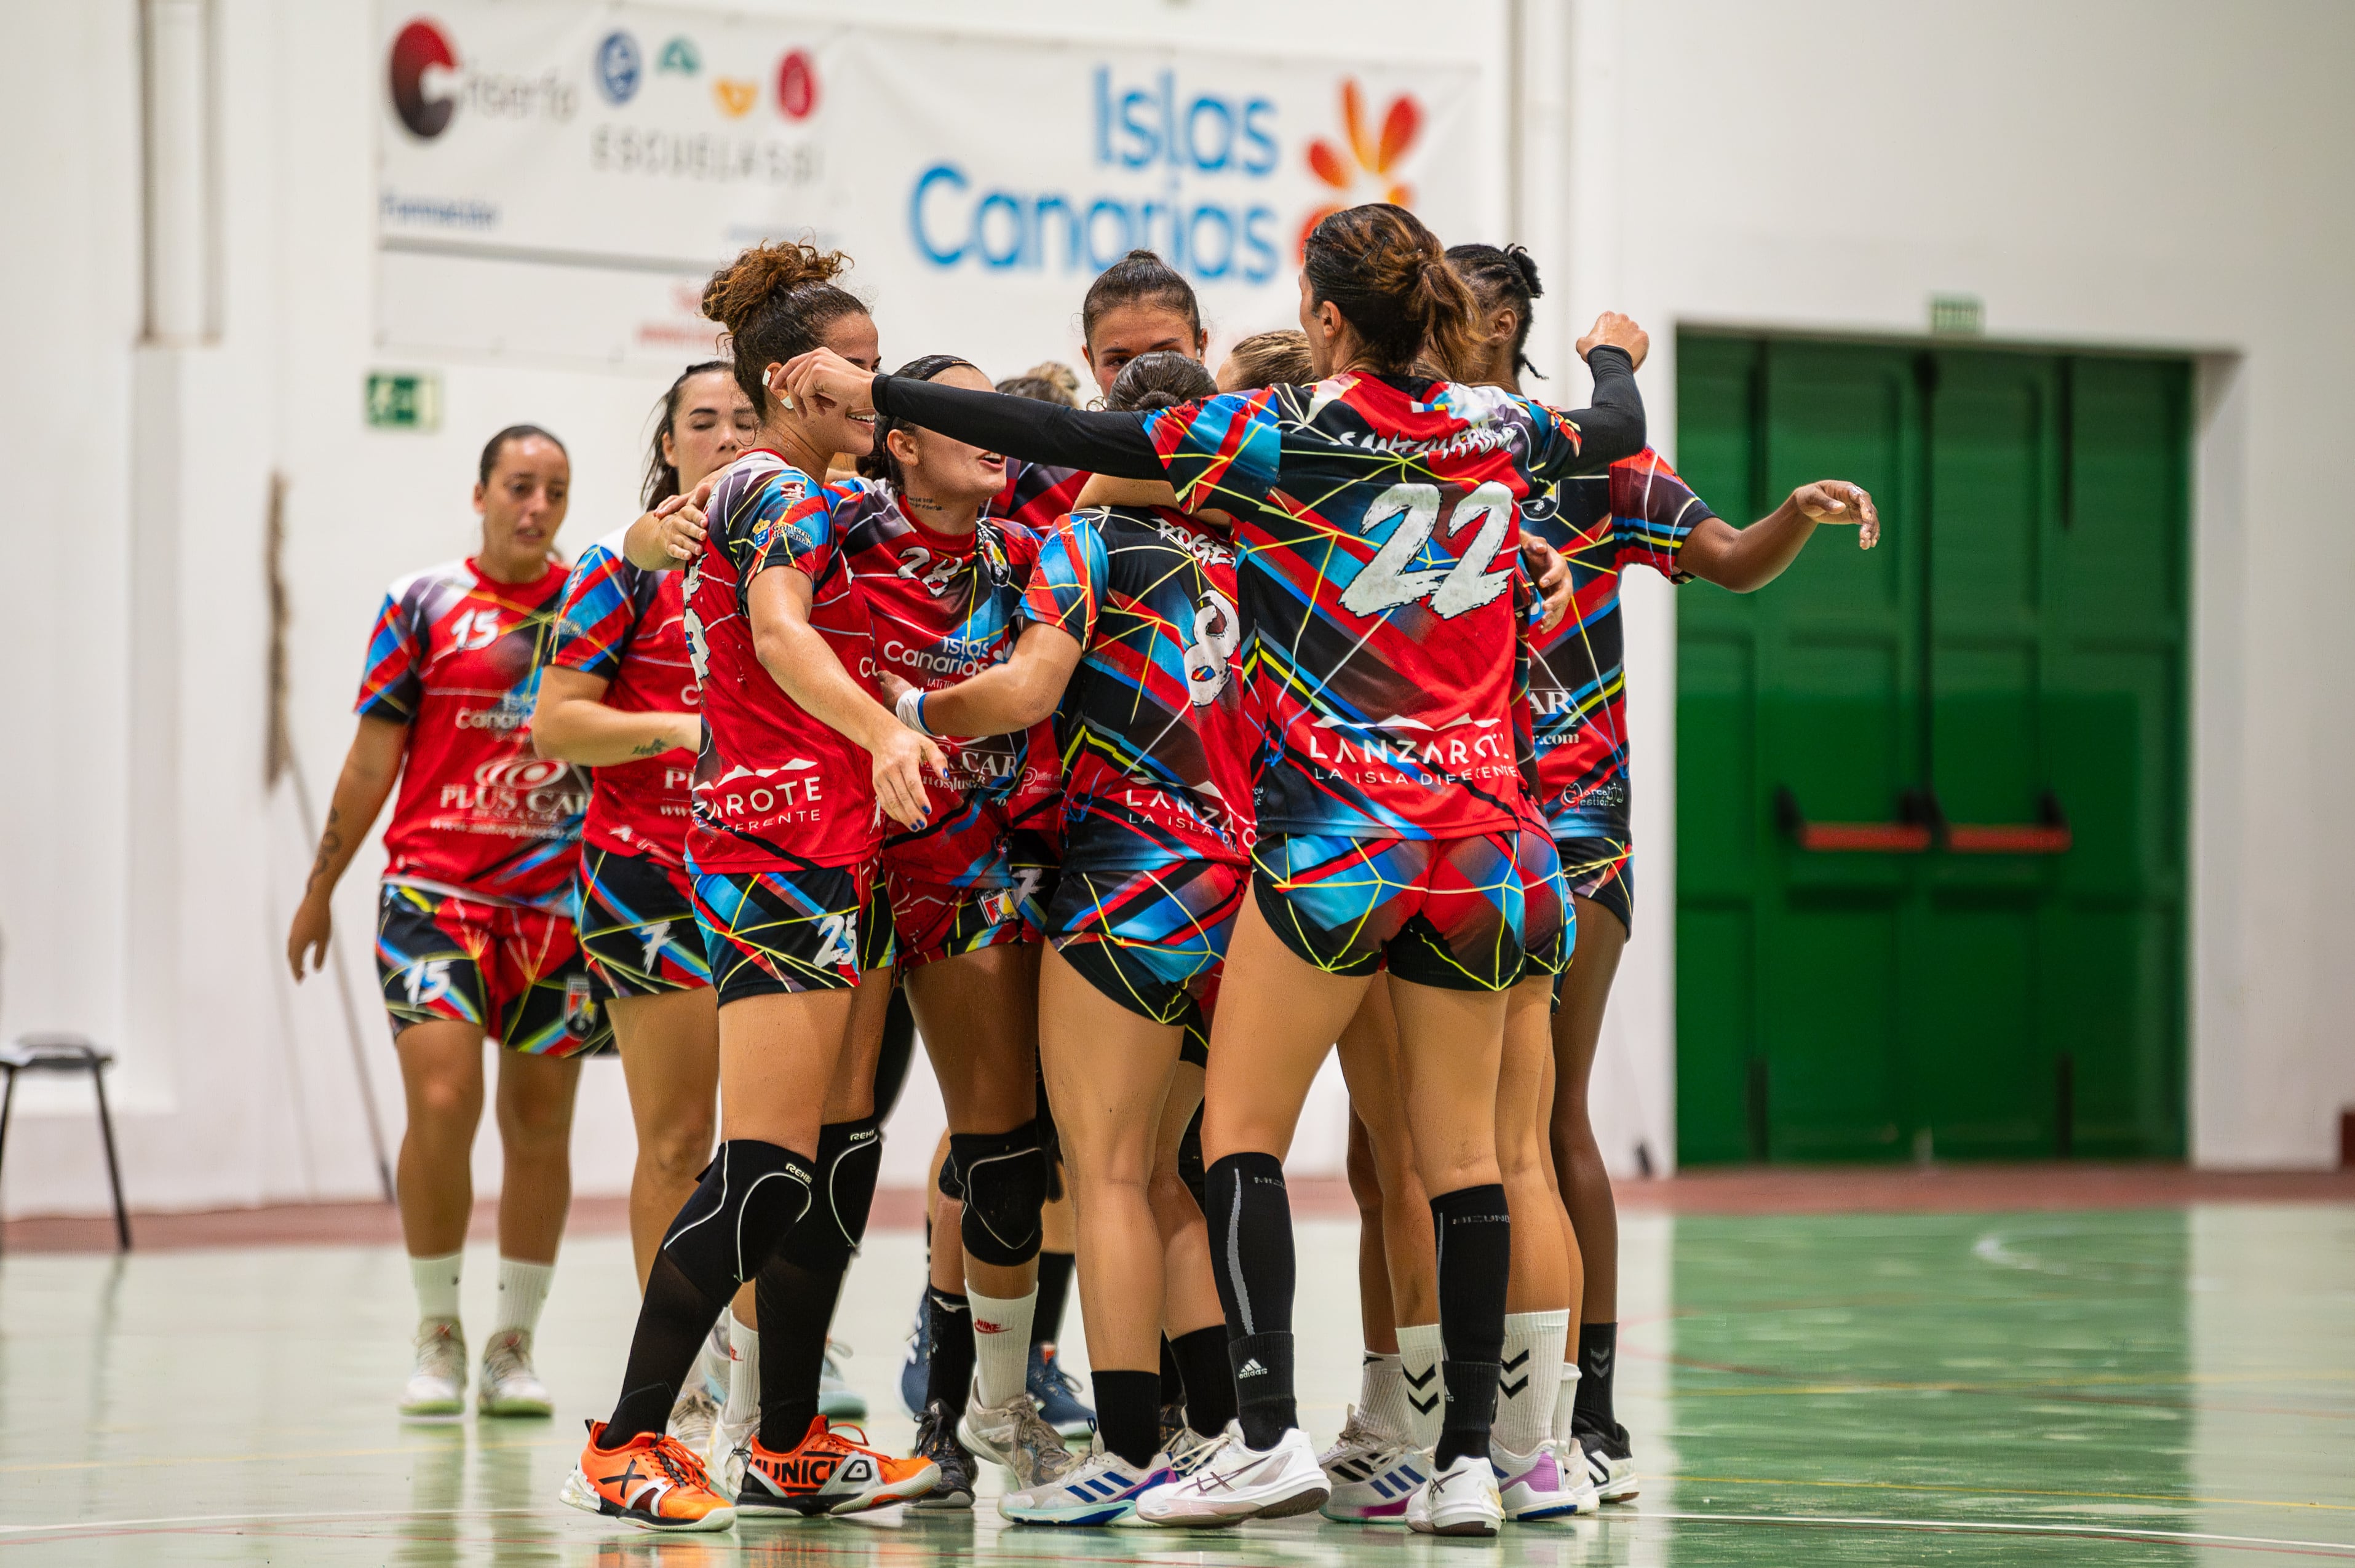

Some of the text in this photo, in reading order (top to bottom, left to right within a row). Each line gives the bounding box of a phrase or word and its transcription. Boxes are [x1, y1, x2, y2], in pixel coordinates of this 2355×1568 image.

[1093, 65, 1280, 176] Islas
[909, 162, 1280, 285] Canarias
[897, 547, 963, 596] 28
[1338, 481, 1514, 619] 22
[450, 608, 501, 652] 15
[942, 636, 988, 659] Islas
[1183, 587, 1241, 707] 8
[440, 783, 518, 811] PLUS
[1315, 768, 1344, 780] LA
[1356, 772, 1409, 785] ISLA
[1129, 814, 1212, 837] LA ISLA
[404, 960, 451, 1009] 15
[1239, 1368, 1268, 1379] adidas
